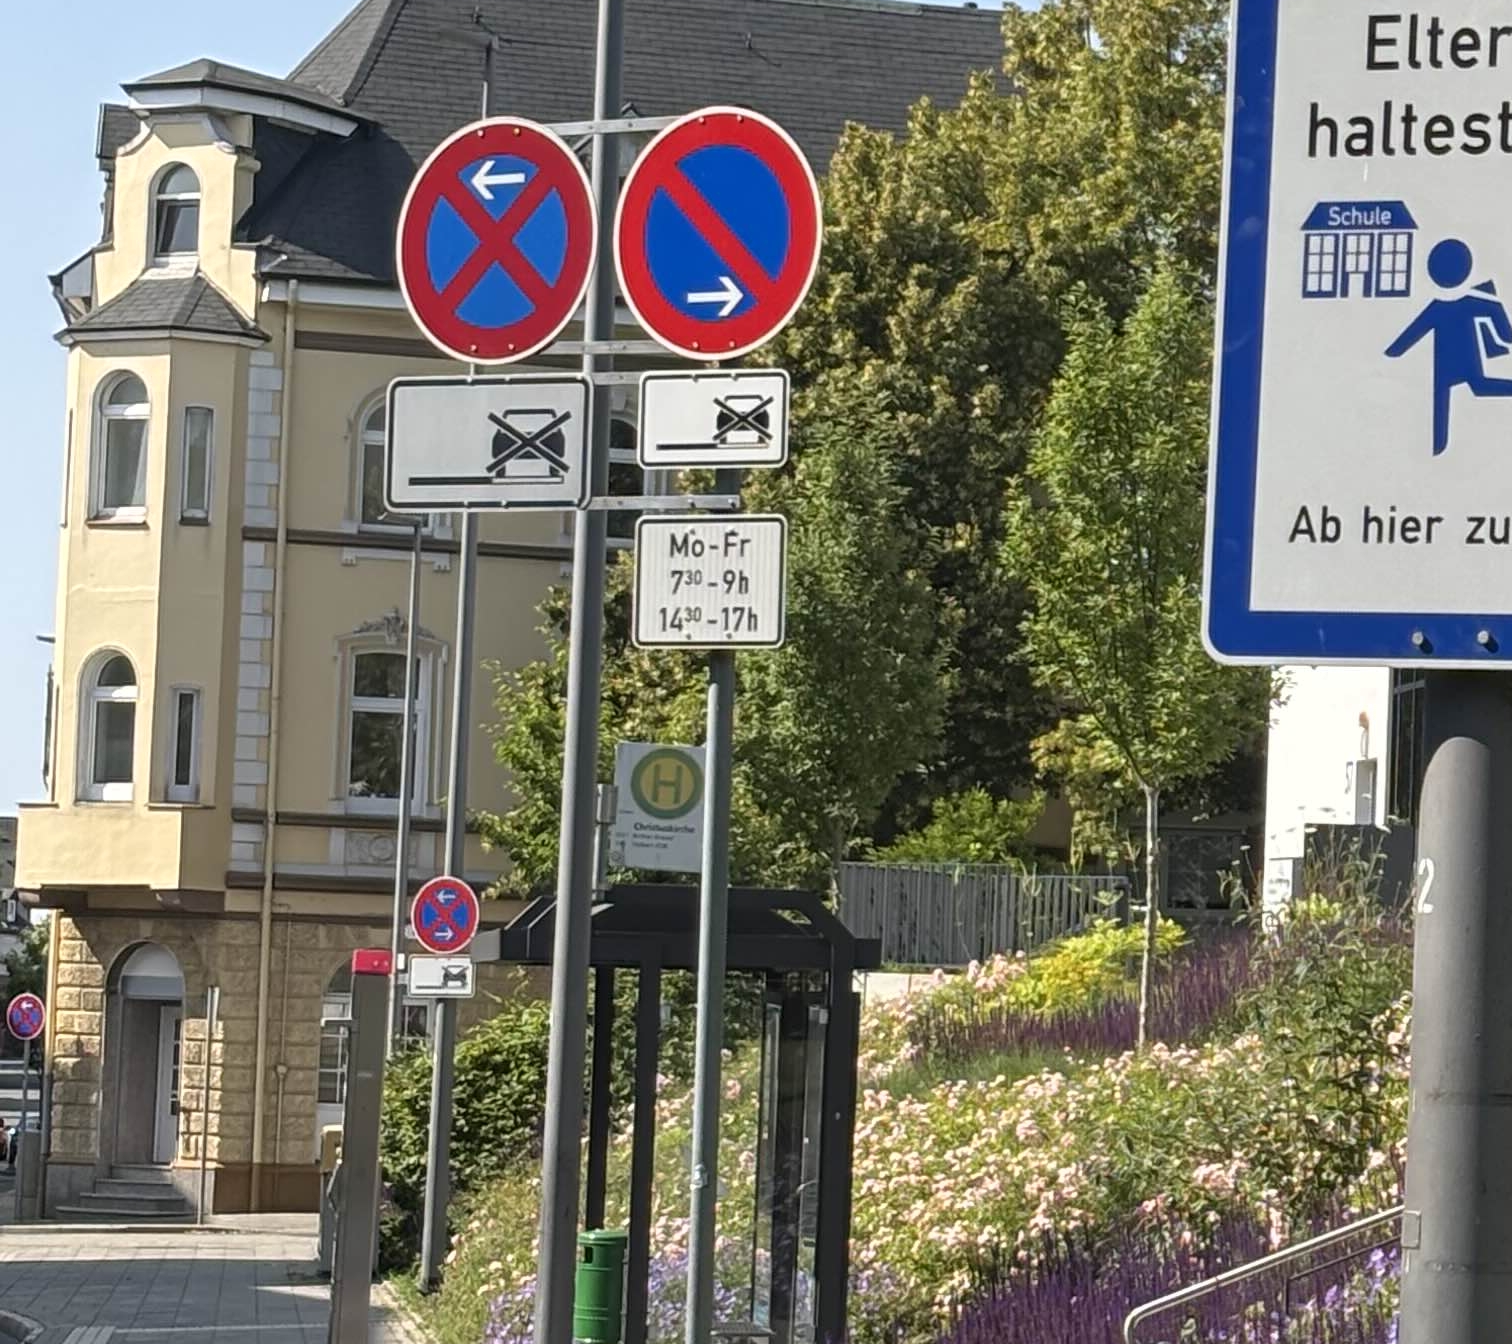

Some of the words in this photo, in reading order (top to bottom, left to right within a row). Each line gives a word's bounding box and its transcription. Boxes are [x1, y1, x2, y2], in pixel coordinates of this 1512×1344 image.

[1328, 206, 1391, 226] Schule
[1289, 505, 1341, 544] Ab
[1362, 505, 1444, 544] hier
[1465, 516, 1510, 545] zu
[651, 763, 683, 805] H
